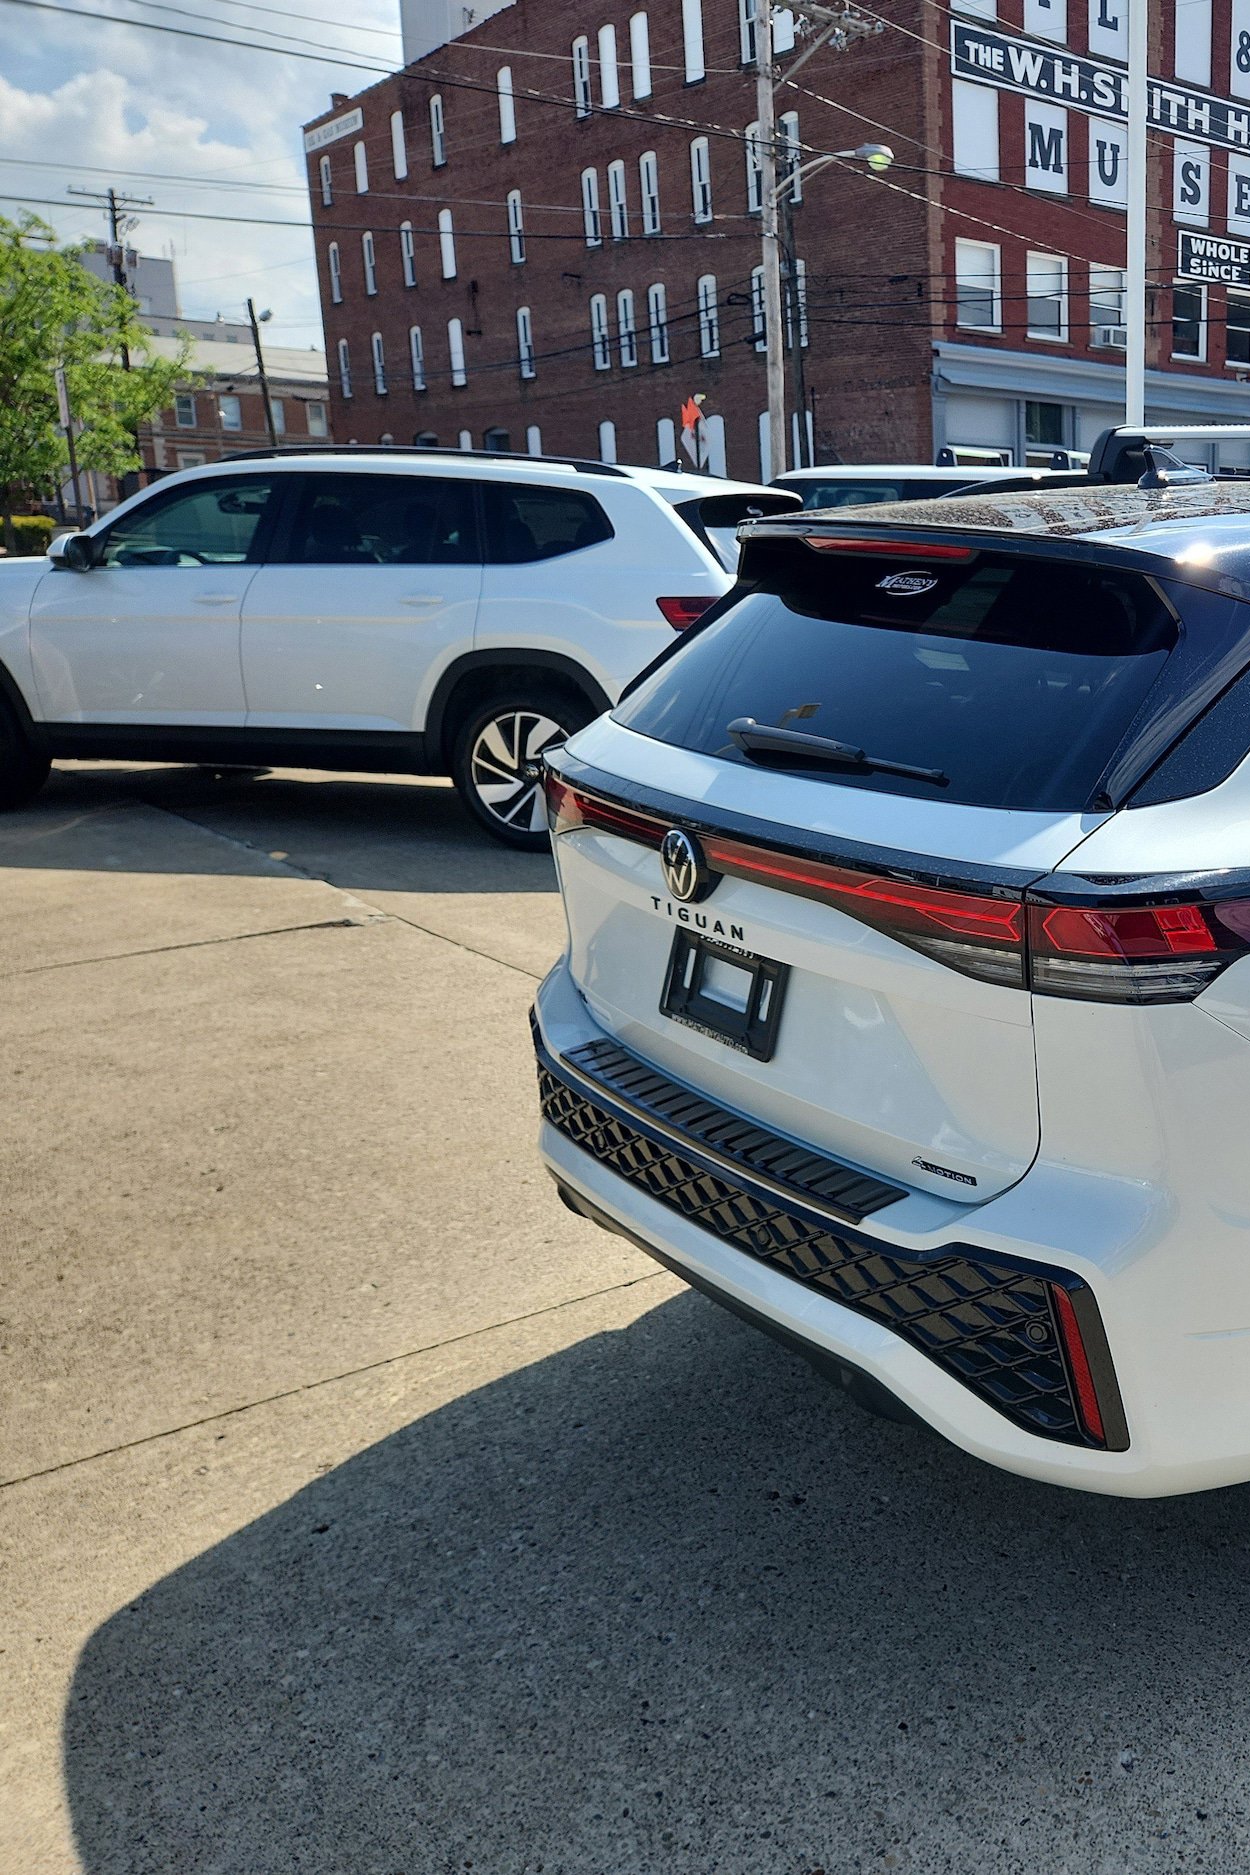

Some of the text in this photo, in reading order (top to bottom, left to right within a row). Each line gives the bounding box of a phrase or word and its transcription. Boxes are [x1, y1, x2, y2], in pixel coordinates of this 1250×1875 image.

[964, 39, 1004, 72] THE
[1092, 71, 1210, 134] SITH
[1189, 257, 1242, 281] SINCE
[650, 895, 744, 941] TIGUAN
